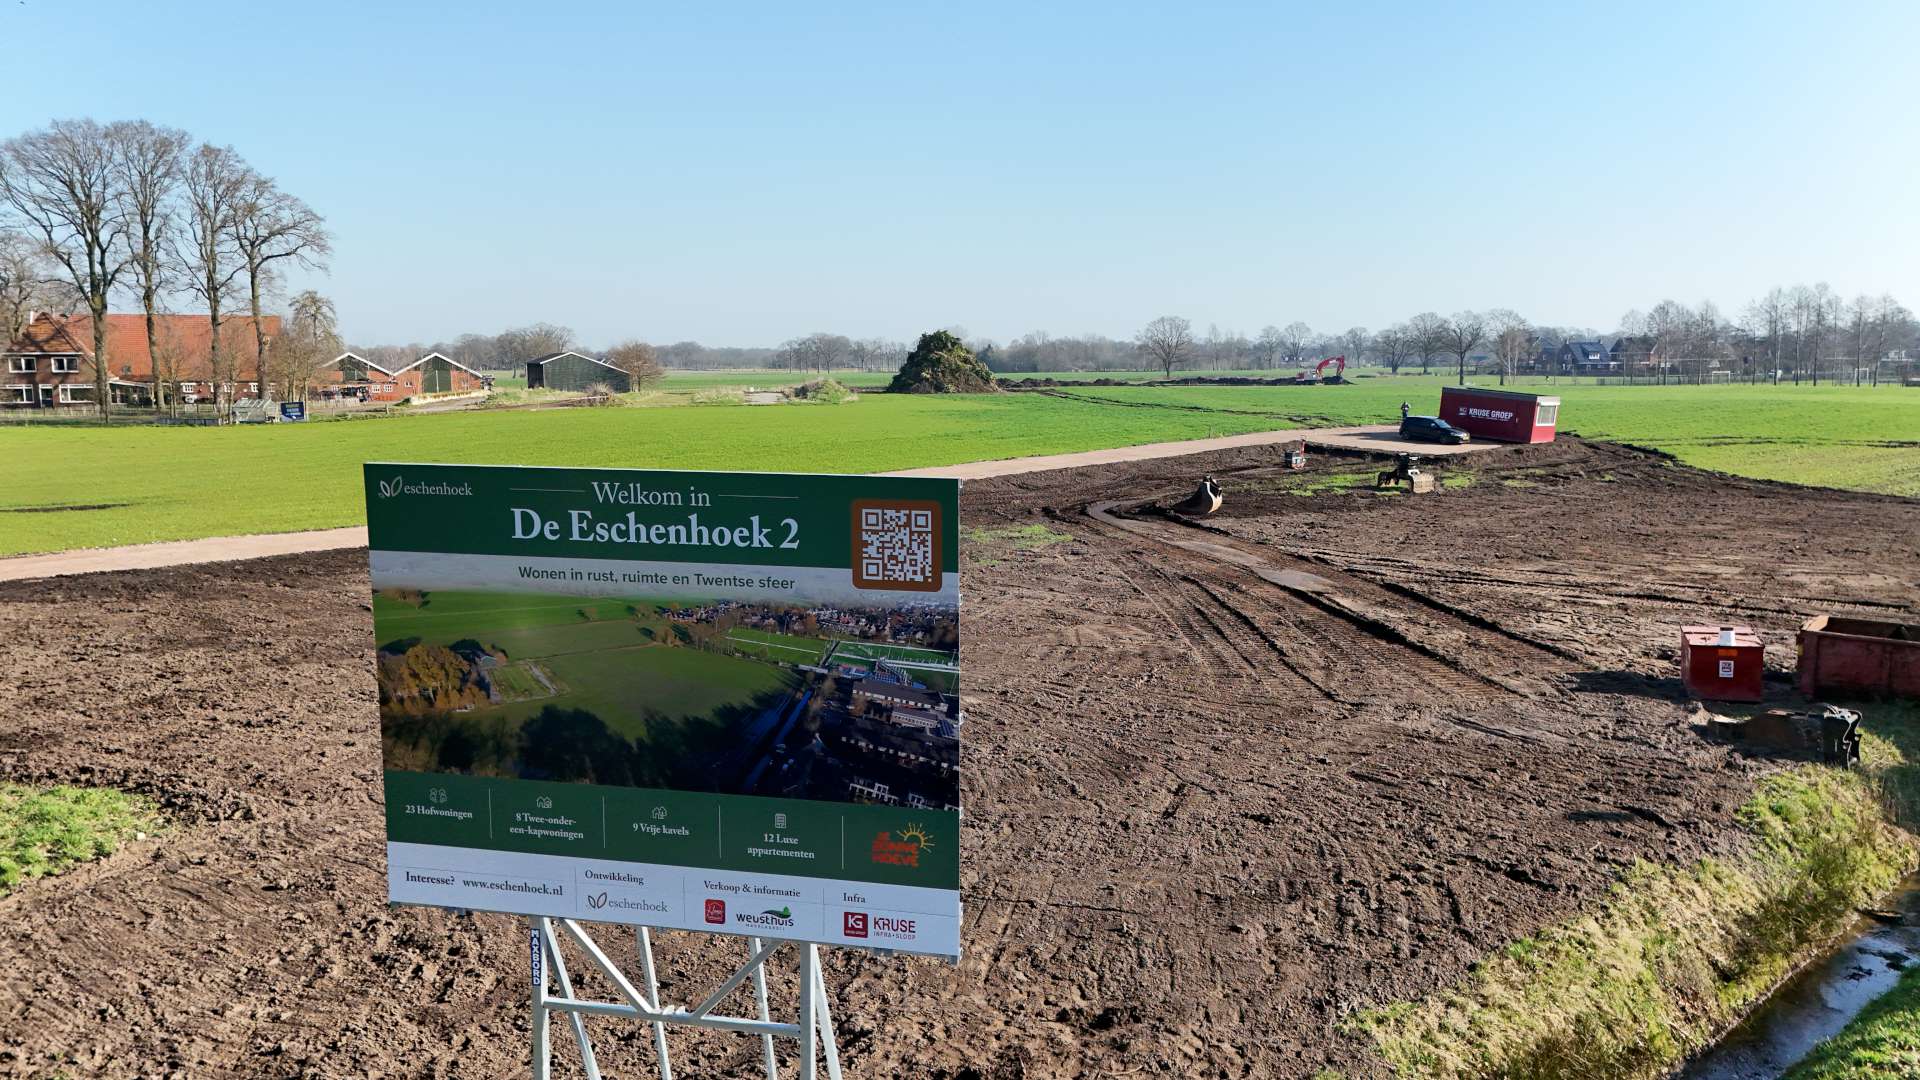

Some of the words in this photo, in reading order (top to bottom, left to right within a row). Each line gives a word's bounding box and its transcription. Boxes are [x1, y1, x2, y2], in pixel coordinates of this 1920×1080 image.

[404, 481, 472, 496] eschenhoek
[592, 481, 683, 506] Welkom
[690, 486, 712, 507] in
[510, 508, 560, 541] De
[568, 510, 774, 548] Eschenhoek
[779, 518, 800, 549] 2
[518, 566, 566, 581] Wonen
[570, 568, 583, 581] in
[587, 570, 618, 585] rust,
[622, 571, 668, 586] ruimte
[672, 575, 690, 586] en
[694, 573, 754, 588] Twentse
[758, 576, 796, 590] sfeer
[405, 805, 416, 814] 23
[416, 805, 473, 820] Hofwoningen
[516, 813, 521, 822] 8
[522, 813, 577, 827] Twee-onder-
[509, 826, 584, 840] een-kapwoningen
[632, 823, 638, 832] 9
[640, 823, 661, 836] Vrije
[662, 825, 689, 836] kavels
[764, 833, 775, 843] 12
[776, 834, 799, 845] Luxe
[747, 847, 815, 860] appartementen
[406, 871, 455, 886] Interesse?
[462, 878, 563, 897] www.eschenhoek.nl
[585, 869, 645, 886] Ontwikkeling
[704, 880, 740, 895] Verkoop
[742, 884, 752, 893] &
[754, 884, 801, 898] informatie
[843, 892, 866, 903] Infra
[608, 898, 668, 913] eschenhoek
[736, 913, 795, 927] weusthuis
[848, 914, 864, 929] KG
[873, 917, 916, 933] KRUSE
[531, 929, 541, 985] MAXBORD
